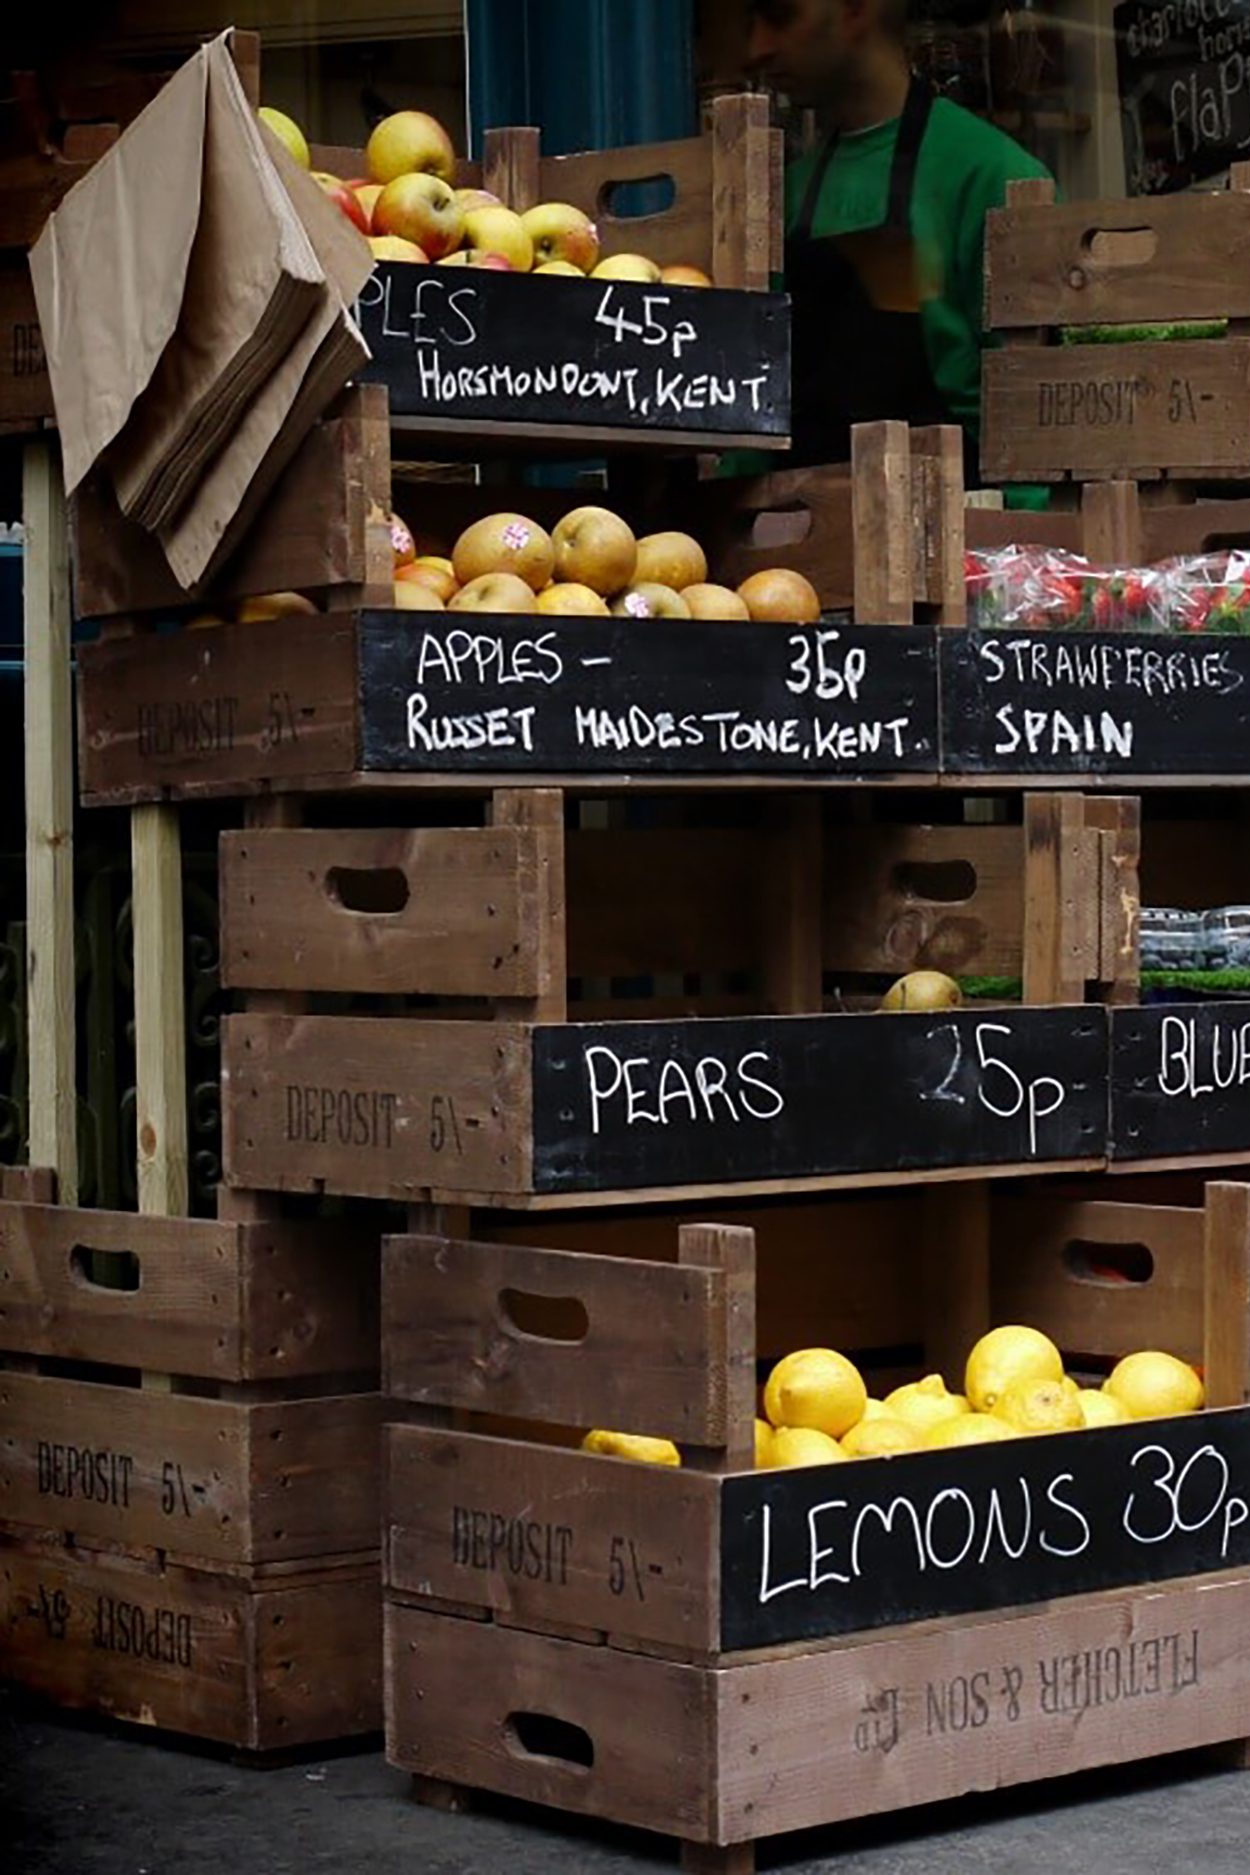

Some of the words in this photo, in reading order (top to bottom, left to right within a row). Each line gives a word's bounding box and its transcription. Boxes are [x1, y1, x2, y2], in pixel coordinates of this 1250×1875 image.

[595, 285, 698, 357] 45p
[1038, 382, 1138, 428] DEPOSIT
[416, 630, 563, 686] APPLES
[785, 630, 865, 700] 35p
[406, 693, 536, 752] RUSSET
[994, 702, 1134, 758] SPAIN
[284, 1084, 399, 1149] DEPOSIT
[585, 1045, 784, 1134] PEARS
[919, 1022, 1066, 1154] 25p
[36, 1439, 134, 1509] DEPOSIT
[451, 1504, 574, 1586] DEPOSIT
[760, 1473, 1090, 1603] LEMONS
[1123, 1443, 1249, 1557] 30p
[925, 1675, 990, 1737] SON
[1005, 1667, 1025, 1722] &
[1038, 1629, 1201, 1715] FLETCHER
